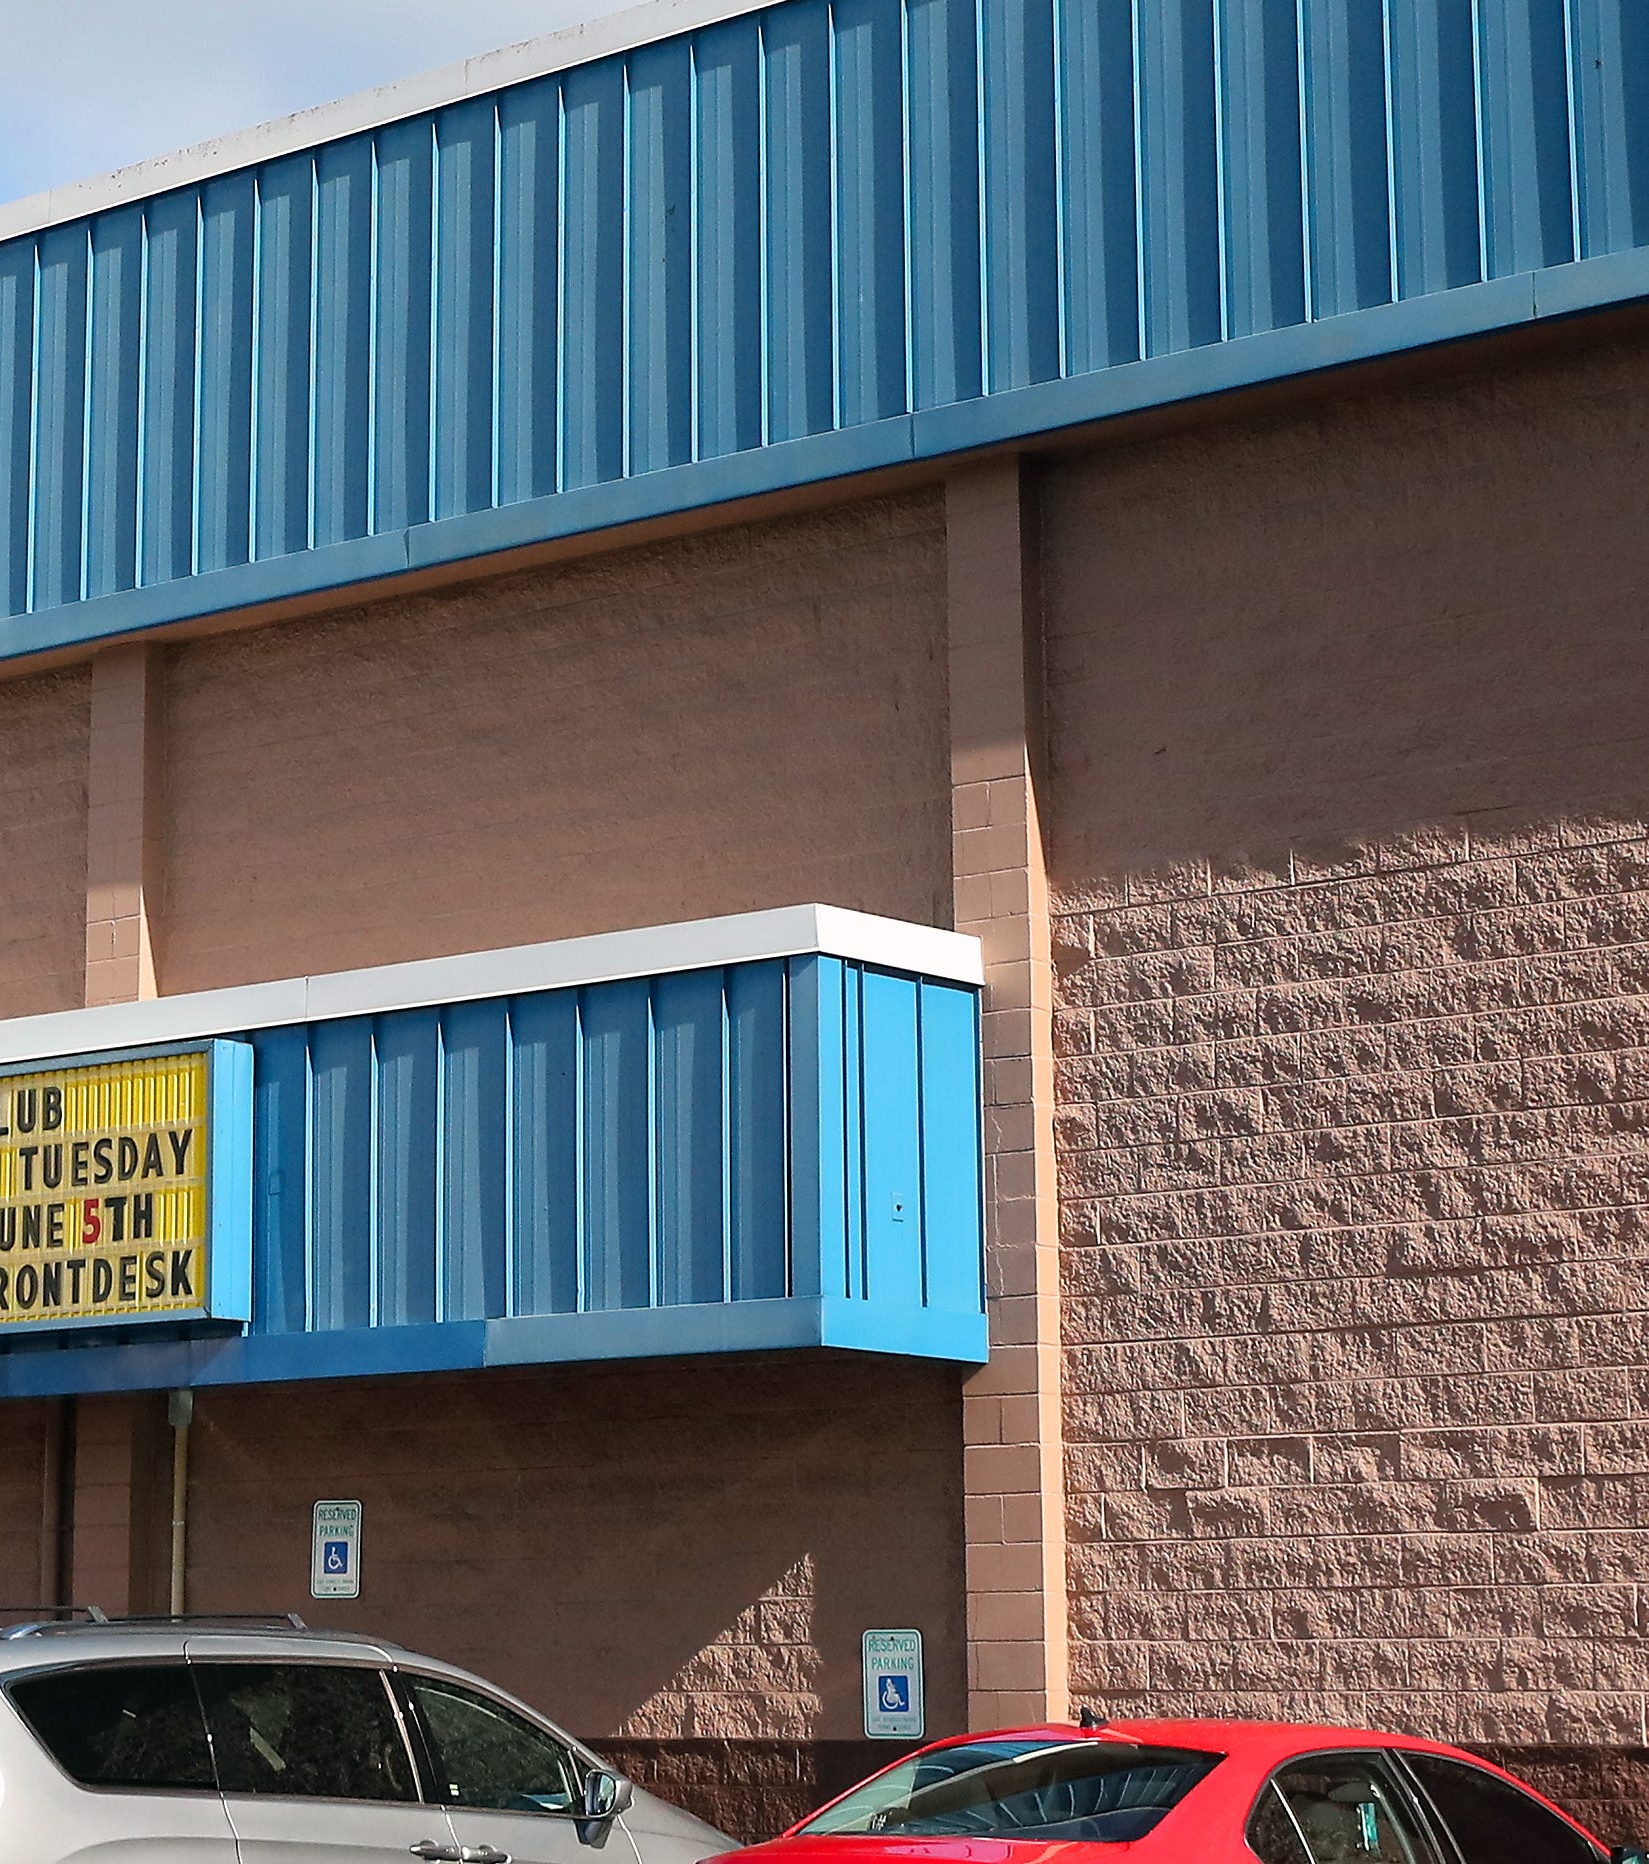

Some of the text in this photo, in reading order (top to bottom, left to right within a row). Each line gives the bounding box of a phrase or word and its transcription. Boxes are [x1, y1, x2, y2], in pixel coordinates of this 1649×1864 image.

[19, 1129, 193, 1191] TUESDAY
[82, 1192, 153, 1245] 5TH
[318, 1508, 357, 1520] RESERVED
[319, 1525, 355, 1537] PARKING
[868, 1639, 916, 1652] RESERVED
[871, 1657, 914, 1670] PARKING
